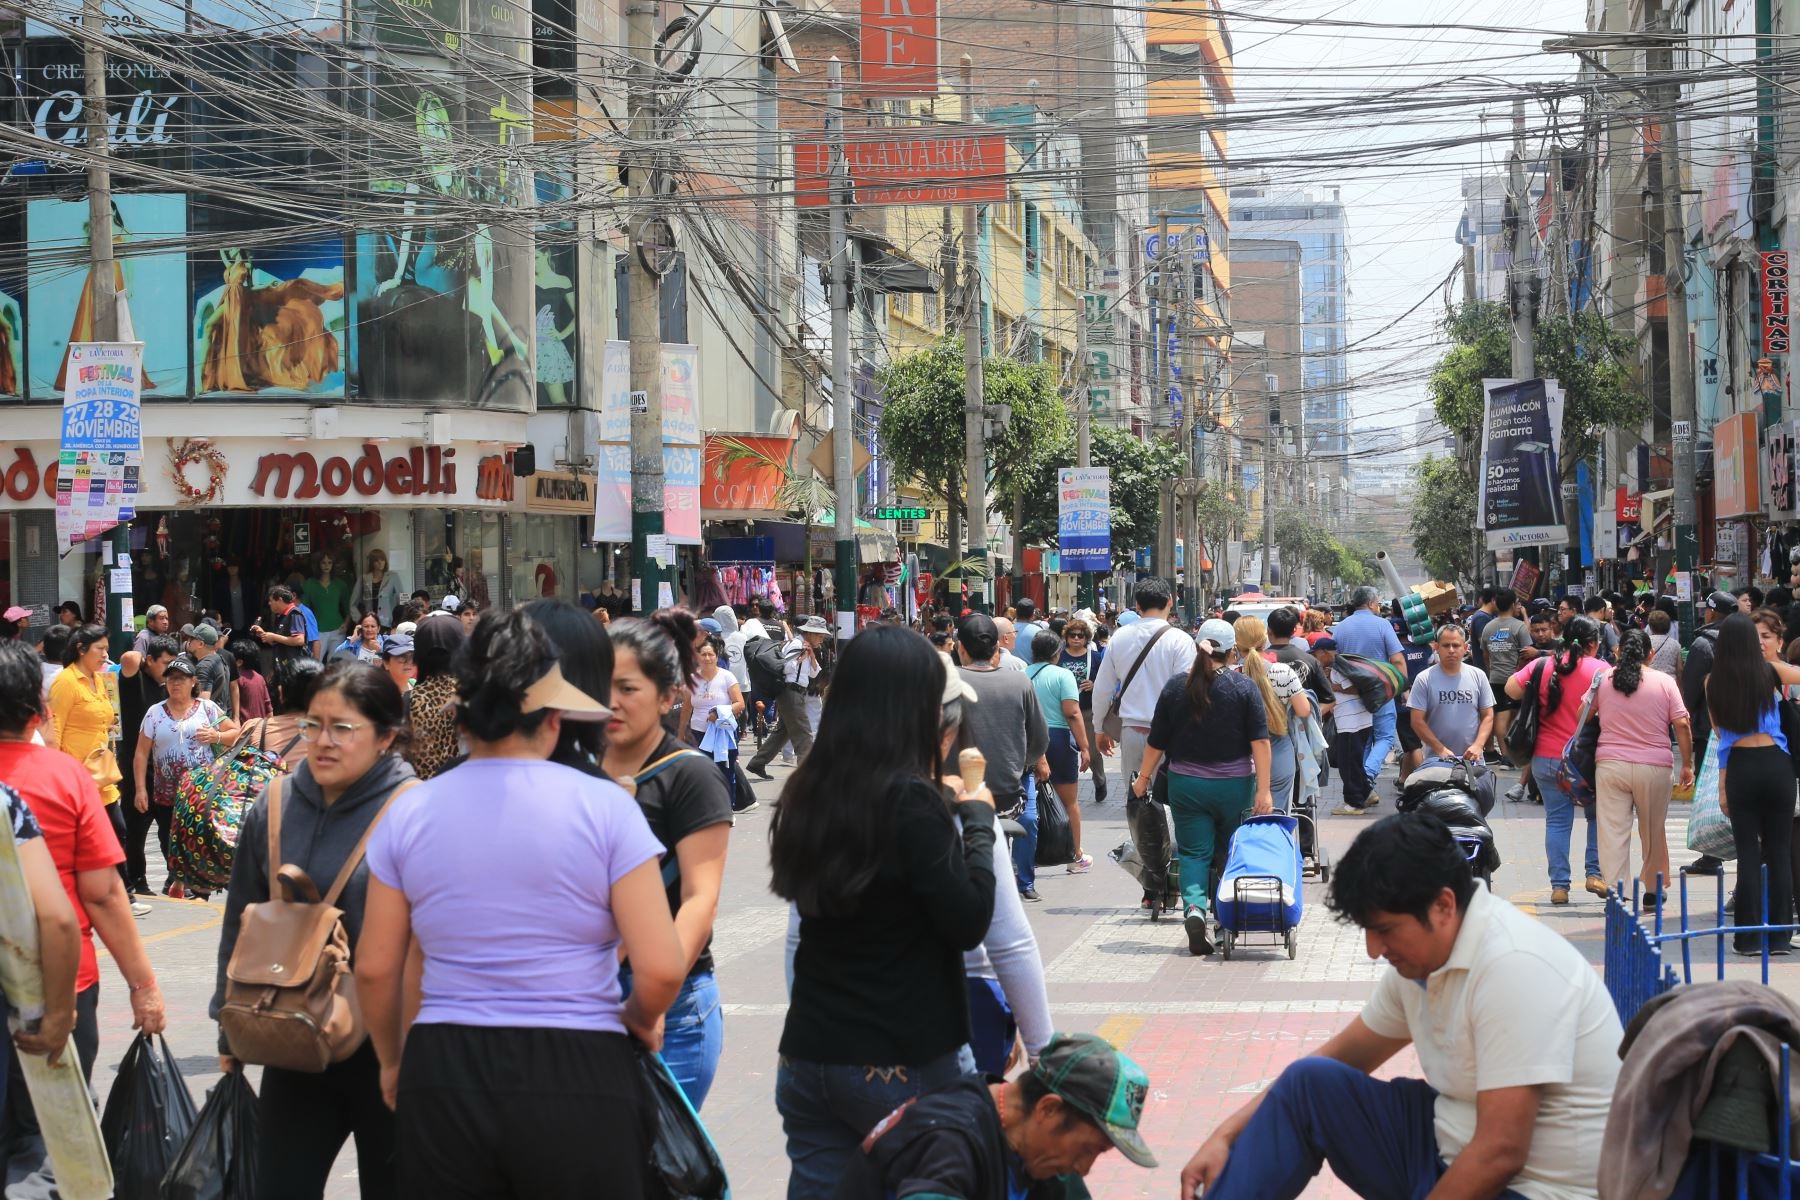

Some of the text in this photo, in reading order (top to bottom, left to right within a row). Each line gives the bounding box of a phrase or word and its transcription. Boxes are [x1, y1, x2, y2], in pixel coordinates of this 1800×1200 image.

[491, 4, 514, 24] GILDA
[535, 27, 553, 36] 246
[1766, 253, 1789, 352] CORTINAS
[79, 363, 134, 384] FESTIVAL
[75, 386, 134, 399] ROPA INTERIOR
[1490, 400, 1541, 419] ILUMINACIÓN
[65, 418, 139, 438] NOVIEMBRE
[1489, 419, 1503, 430] LED
[1513, 414, 1532, 424] todo
[1489, 426, 1533, 440] Gamarra
[249, 443, 457, 499] modelli
[1487, 465, 1504, 479] 50
[1487, 483, 1518, 493] realidad!
[878, 508, 926, 519] LENTES
[1061, 520, 1108, 531] NOVIEMBRE
[1439, 690, 1473, 702] BOSS
